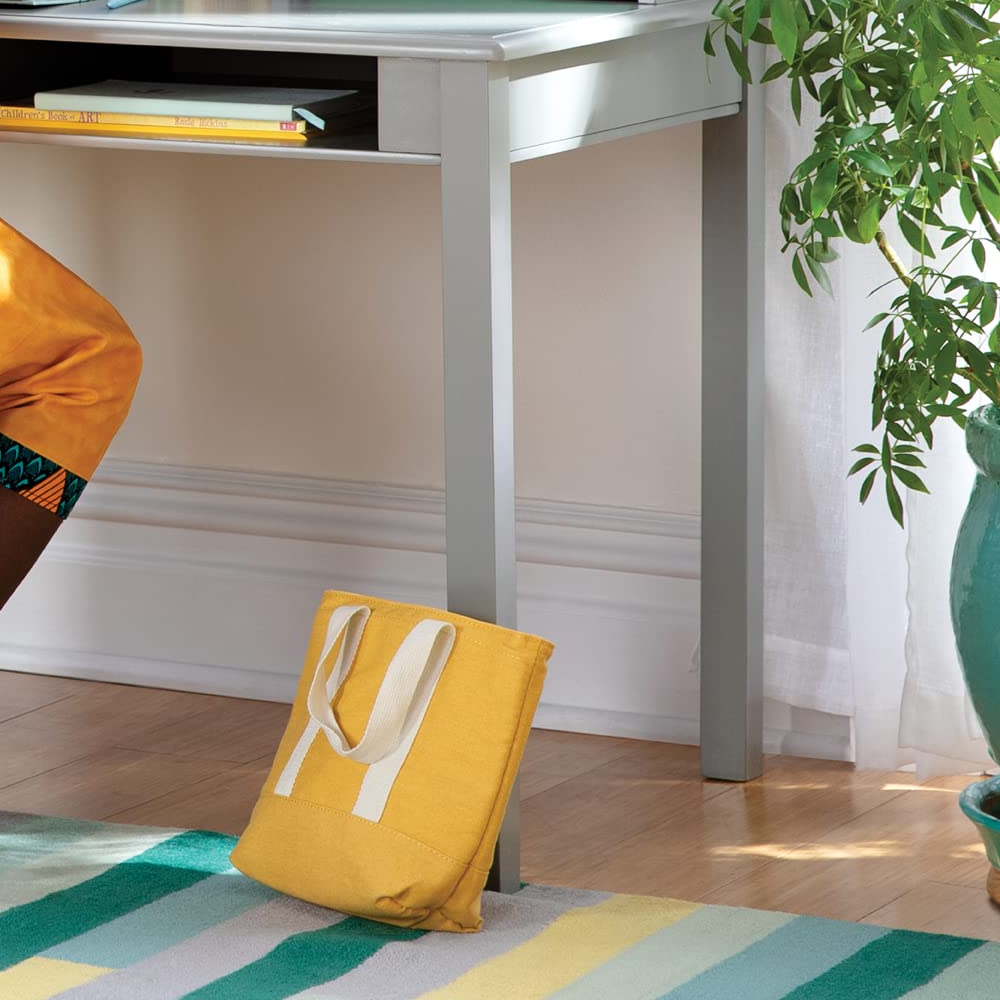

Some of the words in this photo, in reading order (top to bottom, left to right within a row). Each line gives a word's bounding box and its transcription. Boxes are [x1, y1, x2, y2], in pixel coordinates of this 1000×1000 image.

[0, 109, 45, 120] Children's
[48, 111, 68, 121] Book
[78, 112, 101, 123] ART
